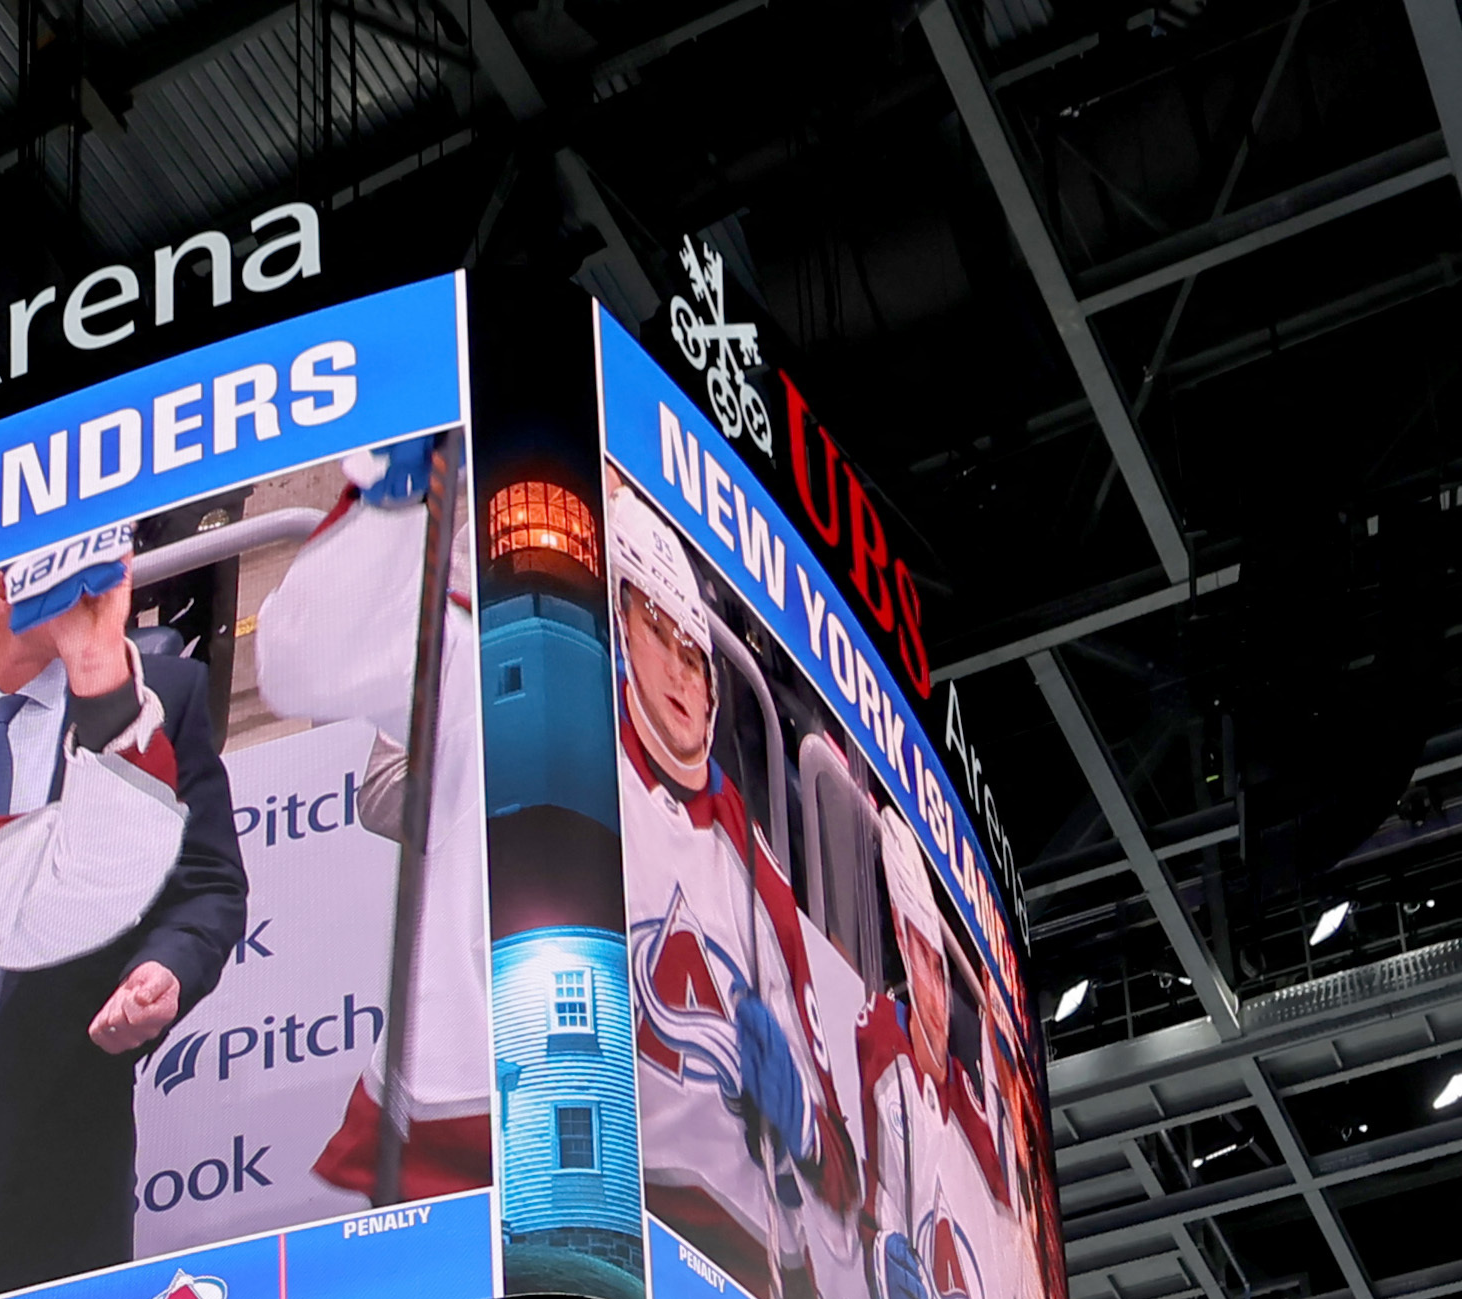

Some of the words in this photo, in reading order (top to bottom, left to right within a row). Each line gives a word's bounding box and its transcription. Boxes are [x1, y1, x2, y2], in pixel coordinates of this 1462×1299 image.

[659, 401, 786, 611] NEW
[796, 563, 911, 794] YORK
[779, 369, 932, 700] UBS
[946, 680, 1032, 958] Arena
[219, 994, 384, 1081] Pitch
[343, 1205, 431, 1238] PENALTY
[678, 1244, 727, 1295] PENALTY
